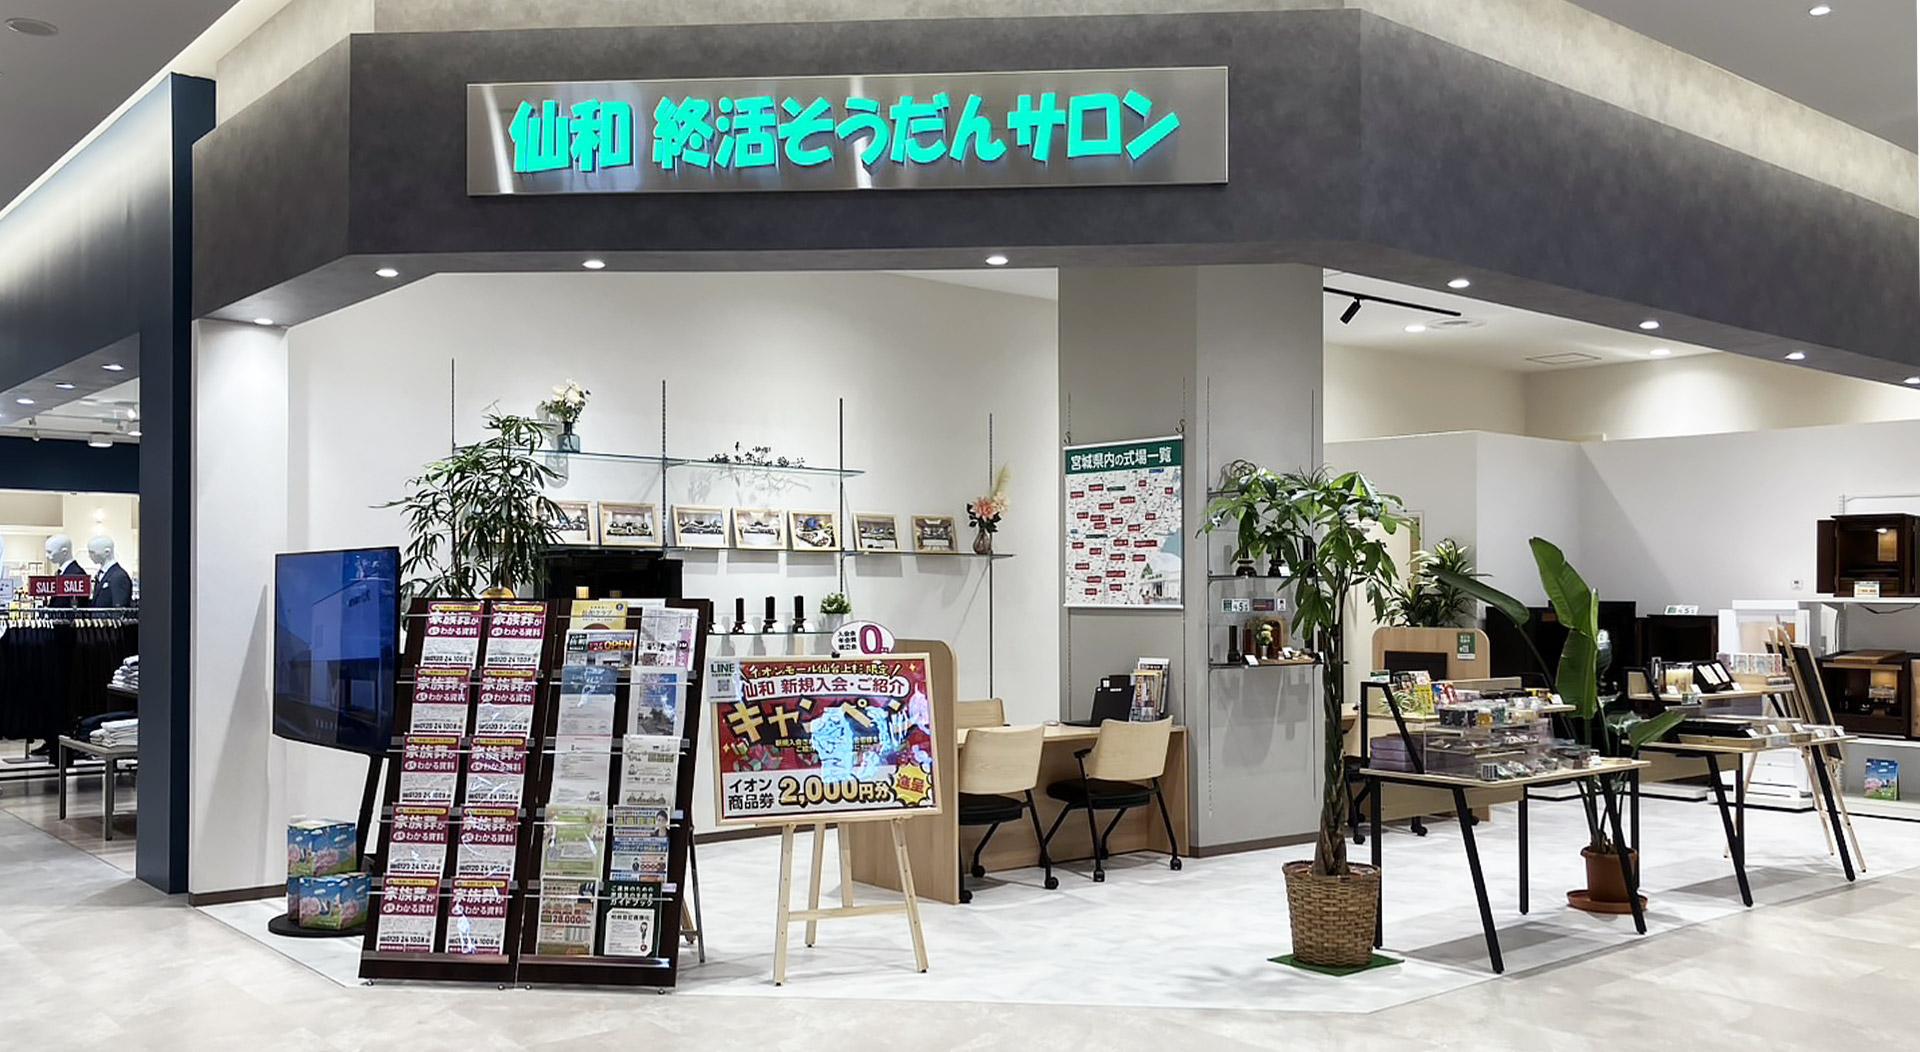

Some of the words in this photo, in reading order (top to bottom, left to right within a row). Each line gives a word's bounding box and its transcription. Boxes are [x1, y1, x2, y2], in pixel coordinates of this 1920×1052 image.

[508, 98, 632, 173] 仙和
[653, 89, 1180, 170] 終活そうだんサロン
[1071, 446, 1172, 470] 宮城県内の式場一覧
[36, 581, 56, 593] SALE
[64, 580, 84, 593] SALE
[710, 663, 735, 673] LINE
[781, 677, 905, 694] 新規入会・ご紹介
[729, 779, 772, 792] イオン
[778, 774, 890, 807] 2,000円分
[897, 775, 925, 795] 進呈
[729, 794, 774, 811] 商品券
